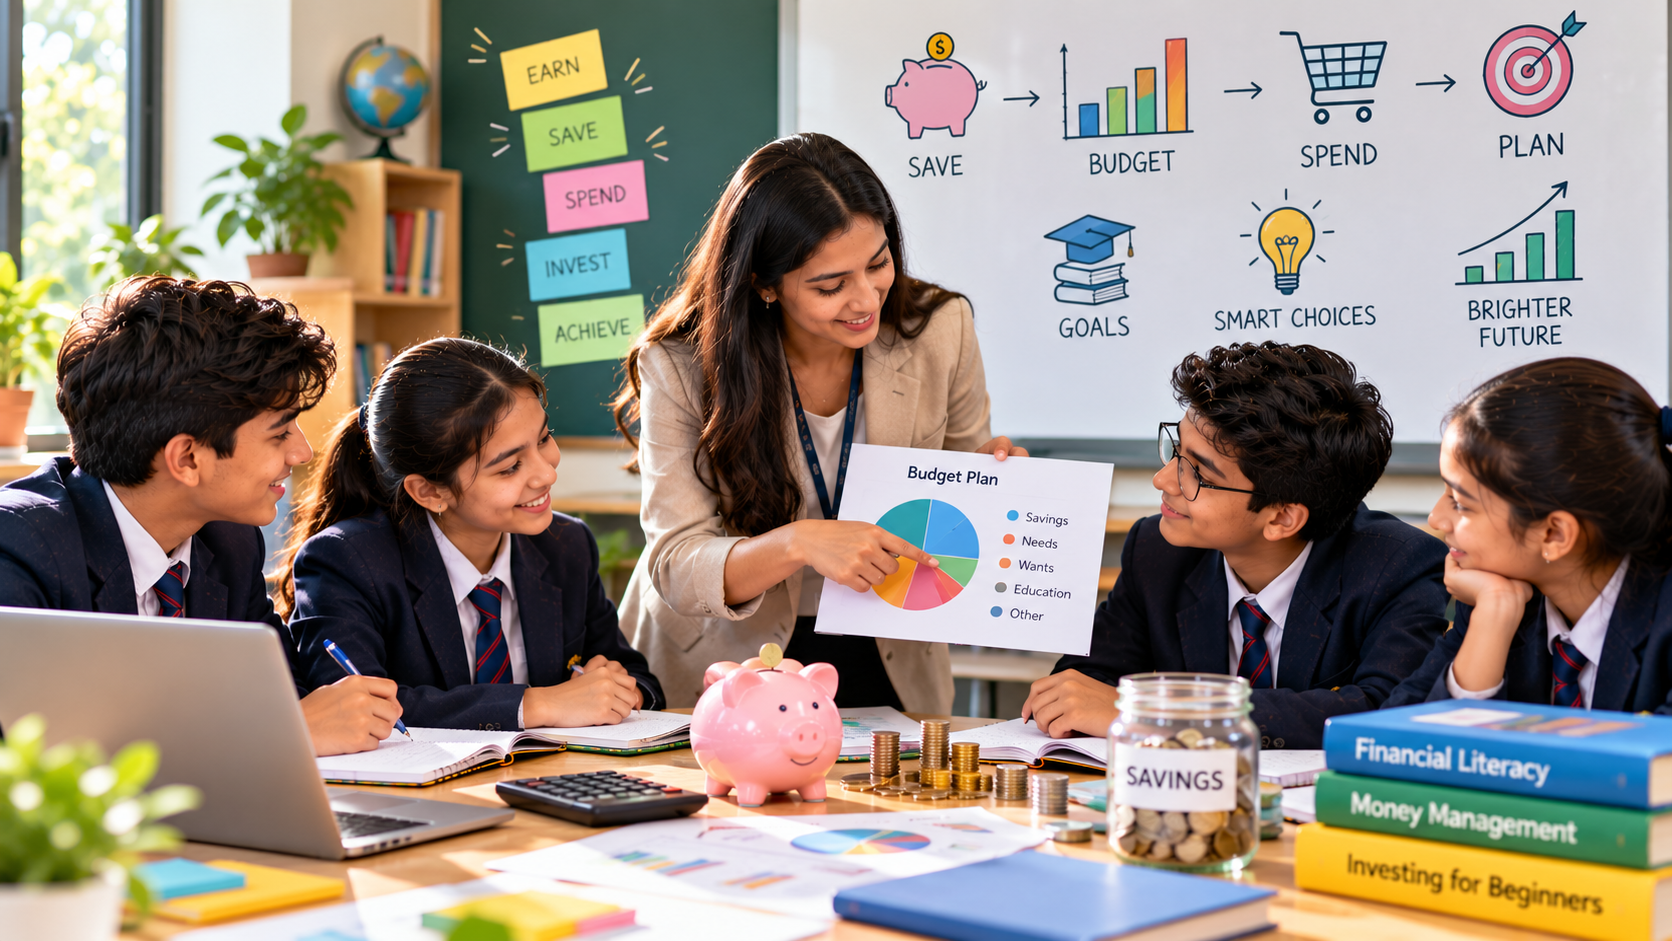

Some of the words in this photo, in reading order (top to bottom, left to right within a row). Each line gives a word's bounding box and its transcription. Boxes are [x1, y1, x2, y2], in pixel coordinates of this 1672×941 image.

[527, 57, 579, 85] EARN
[549, 122, 598, 146] SAVE
[1500, 133, 1563, 158] PLAN
[909, 155, 963, 177] SAVE
[1090, 150, 1175, 175] BUDGET
[1301, 143, 1377, 168] SPEND
[565, 185, 626, 209] SPEND
[545, 252, 610, 278] INVEST
[1215, 309, 1282, 331] SMART
[1291, 305, 1376, 327] CHOICES
[1469, 297, 1572, 320] BRIGHTER
[555, 318, 630, 343] ACHIEVE
[1059, 316, 1129, 338] GOALS
[1480, 325, 1562, 347] FUTURE
[908, 466, 962, 485] Budget
[967, 471, 998, 485] Plan
[1026, 512, 1068, 527] Savings
[1022, 536, 1057, 549] Needs
[1019, 560, 1053, 573] Wants
[1014, 584, 1071, 599] Education
[1010, 608, 1044, 621] Other
[1356, 736, 1452, 770] Financial
[1458, 745, 1550, 787] Literacy
[1127, 766, 1223, 791] SAVINGS
[1351, 792, 1424, 825] Money
[1428, 801, 1578, 845] Management
[1347, 854, 1443, 894] Investing
[1450, 870, 1482, 894] for
[1488, 876, 1604, 915] Beginners
